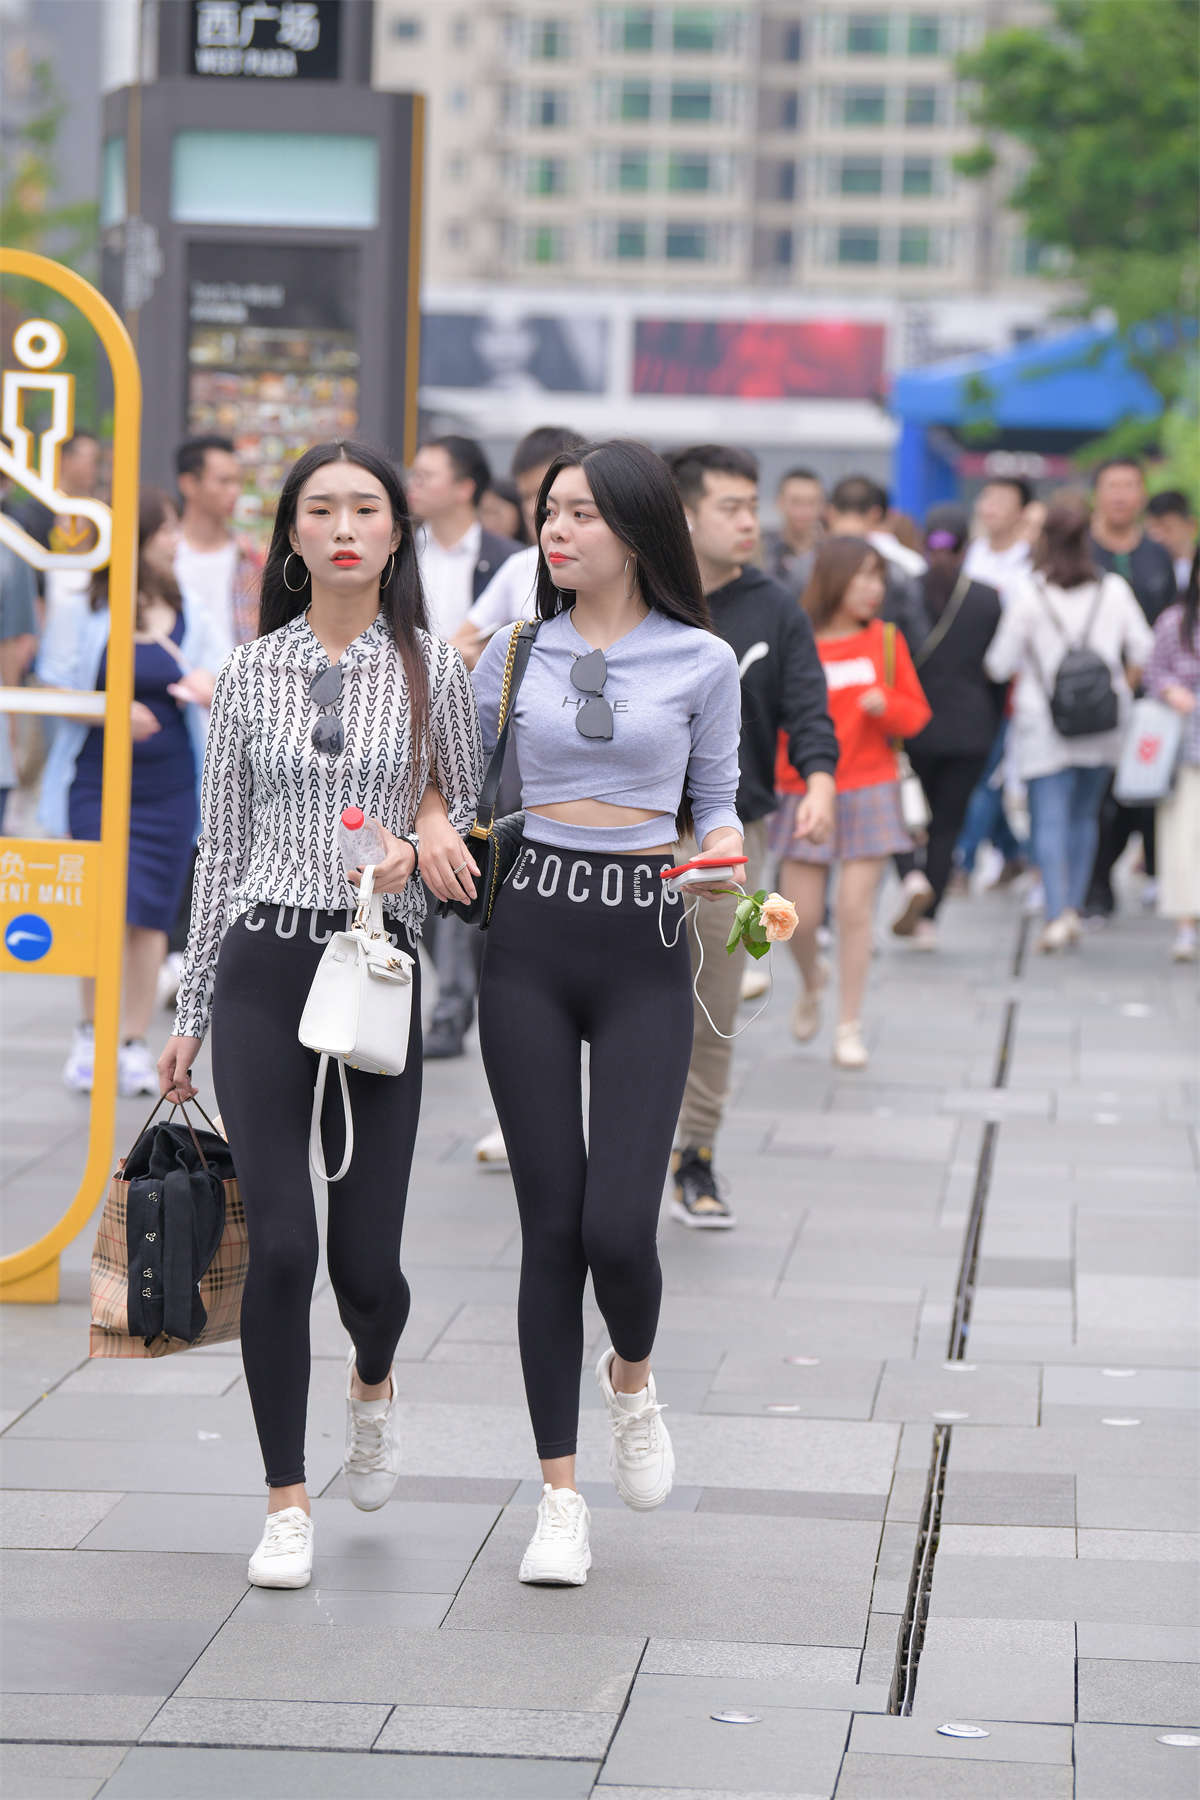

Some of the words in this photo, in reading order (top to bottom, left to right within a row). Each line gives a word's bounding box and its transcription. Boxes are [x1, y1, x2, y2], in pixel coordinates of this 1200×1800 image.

[196, 1, 320, 51] 西广场
[38, 884, 84, 906] MALL
